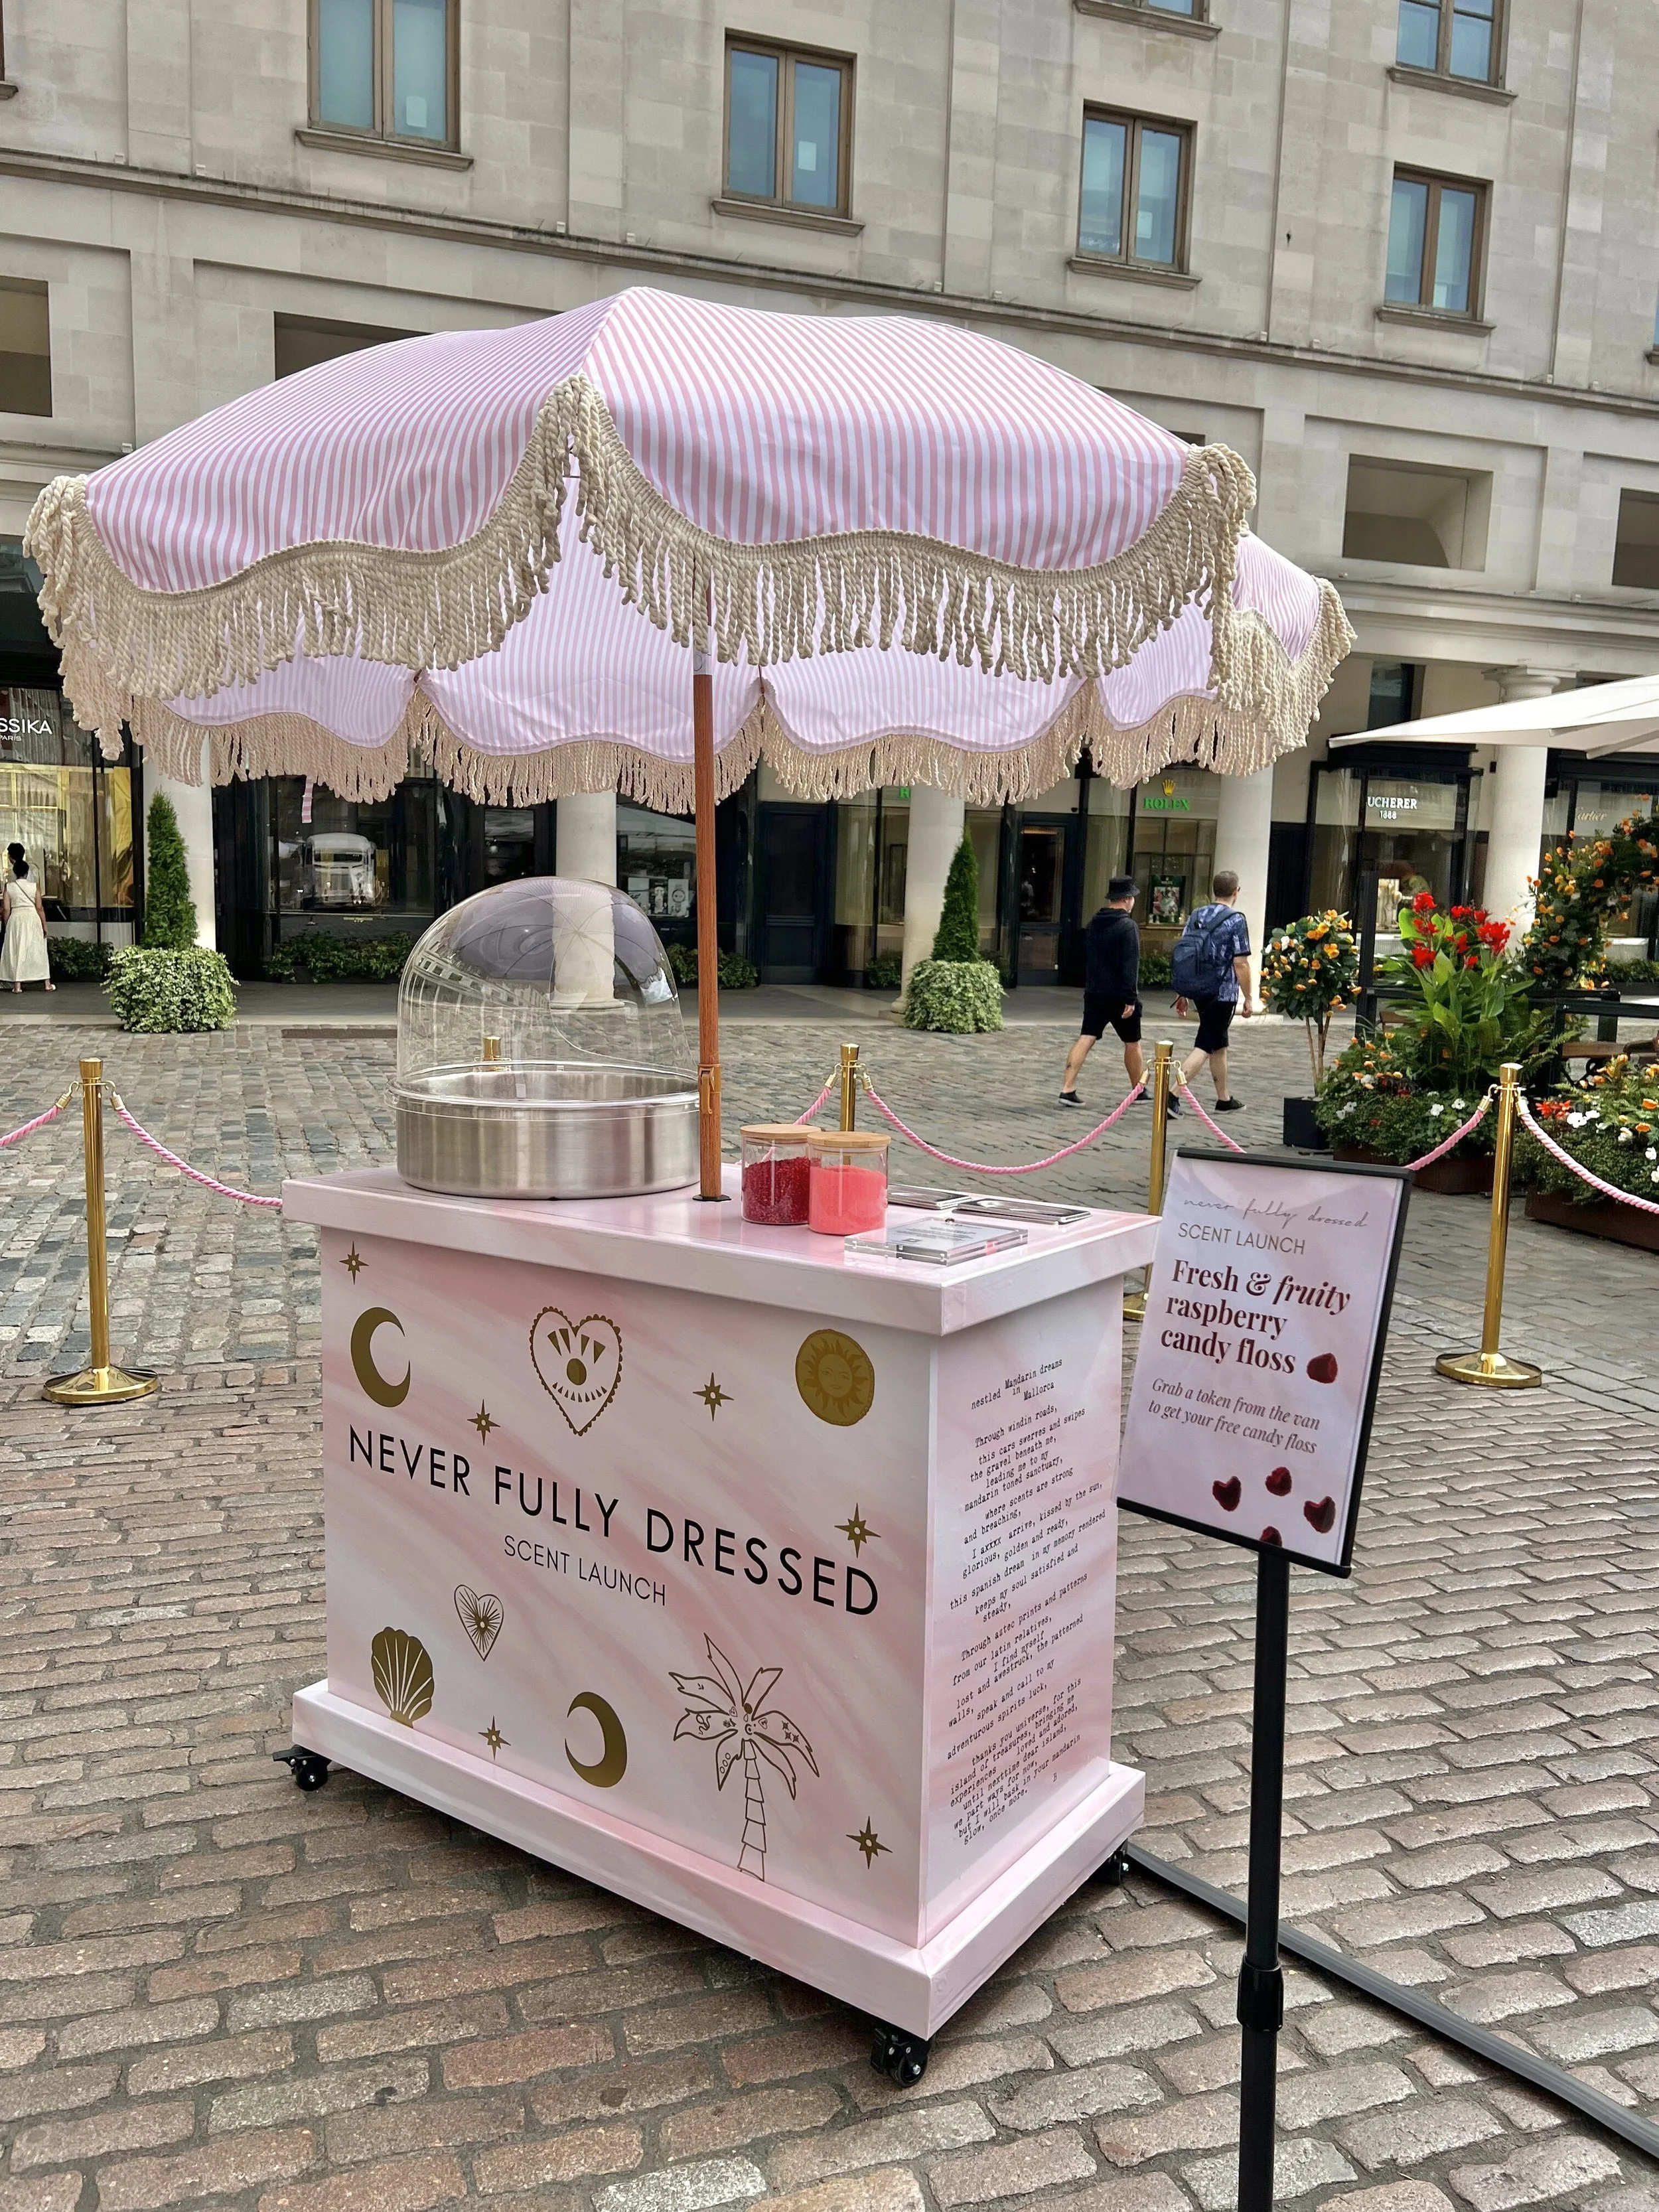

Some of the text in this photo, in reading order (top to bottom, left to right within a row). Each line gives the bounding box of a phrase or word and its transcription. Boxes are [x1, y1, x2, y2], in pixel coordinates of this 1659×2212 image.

[1143, 798, 1190, 810] ROLEX
[1367, 796, 1417, 809] UCHERER
[1380, 810, 1397, 820] 1888
[1575, 807, 1607, 821] artier
[1178, 1222, 1305, 1255] SCENT LAUNCH
[1184, 1199, 1368, 1229] never fully dressed
[1171, 1258, 1350, 1316] Fresh & fruity
[1165, 1295, 1287, 1340] raspberry
[1005, 1359, 1062, 1389] Mandarin dreams
[1161, 1329, 1296, 1374] candy floss
[972, 1382, 1054, 1410] nestled in Mallorca
[1152, 1378, 1320, 1430] Grab a token from the van
[975, 1428, 1004, 1448] Through
[1009, 1416, 1032, 1432] windin
[979, 1408, 1085, 1465] this cars swerves and swipes
[1148, 1400, 1317, 1454] to get your free candy floss
[970, 1470, 982, 1482] the
[987, 1457, 1011, 1476] gravel
[1015, 1440, 1042, 1458] beneath
[986, 1450, 1048, 1488] leading me to my
[965, 1489, 999, 1511] mandarin
[1003, 1475, 1022, 1490] toned
[985, 1467, 1073, 1520] where scents are strong
[349, 1424, 878, 1616] NEVER FULLY DRESSED
[964, 1531, 976, 1544] and
[972, 1548, 976, 1559] I
[1039, 1501, 1062, 1522] kissed
[1066, 1499, 1072, 1507] by
[1076, 1491, 1086, 1501] the
[503, 1535, 666, 1606] SCENT LAUNCH
[950, 1510, 1106, 1610] this spanish dream in my memory rendered
[1004, 1542, 1028, 1561] golden
[1032, 1534, 1043, 1544] and
[975, 1544, 1078, 1615] keeps my soul satisfied and
[962, 1573, 1087, 1661] Through aztec prints and patterns
[953, 1670, 970, 1686] from
[974, 1659, 987, 1671] our
[991, 1643, 1011, 1659] latin
[957, 1693, 974, 1709] lost
[978, 1680, 989, 1694] and
[1037, 1641, 1048, 1653] the
[1051, 1614, 1083, 1641] patterned
[993, 1631, 1044, 1672] I find myself
[977, 1700, 997, 1720] speak
[1001, 1689, 1013, 1702] and
[1017, 1674, 1032, 1691] call
[1047, 1660, 1054, 1670] my
[948, 1721, 993, 1759] adventurous
[998, 1698, 1025, 1722] spirits
[951, 1771, 976, 1795] island
[980, 1760, 989, 1771] of
[1035, 1699, 1064, 1729] bringing
[1067, 1694, 1074, 1704] me
[972, 1743, 996, 1766] thanks
[1000, 1732, 1012, 1746] you
[1053, 1694, 1064, 1705] for
[1068, 1678, 1081, 1692] this
[950, 1767, 996, 1807] experiences
[1017, 1735, 1036, 1755] loved
[1039, 1726, 1050, 1738] and
[959, 1734, 1080, 1837] but I will bask in your mandarin
[964, 1790, 983, 1810] until
[1023, 1747, 1039, 1761] dear
[954, 1818, 962, 1830] we
[967, 1801, 983, 1821] part
[987, 1787, 1003, 1805] ways
[1007, 1775, 1019, 1787] for
[989, 1806, 1005, 1821] once
